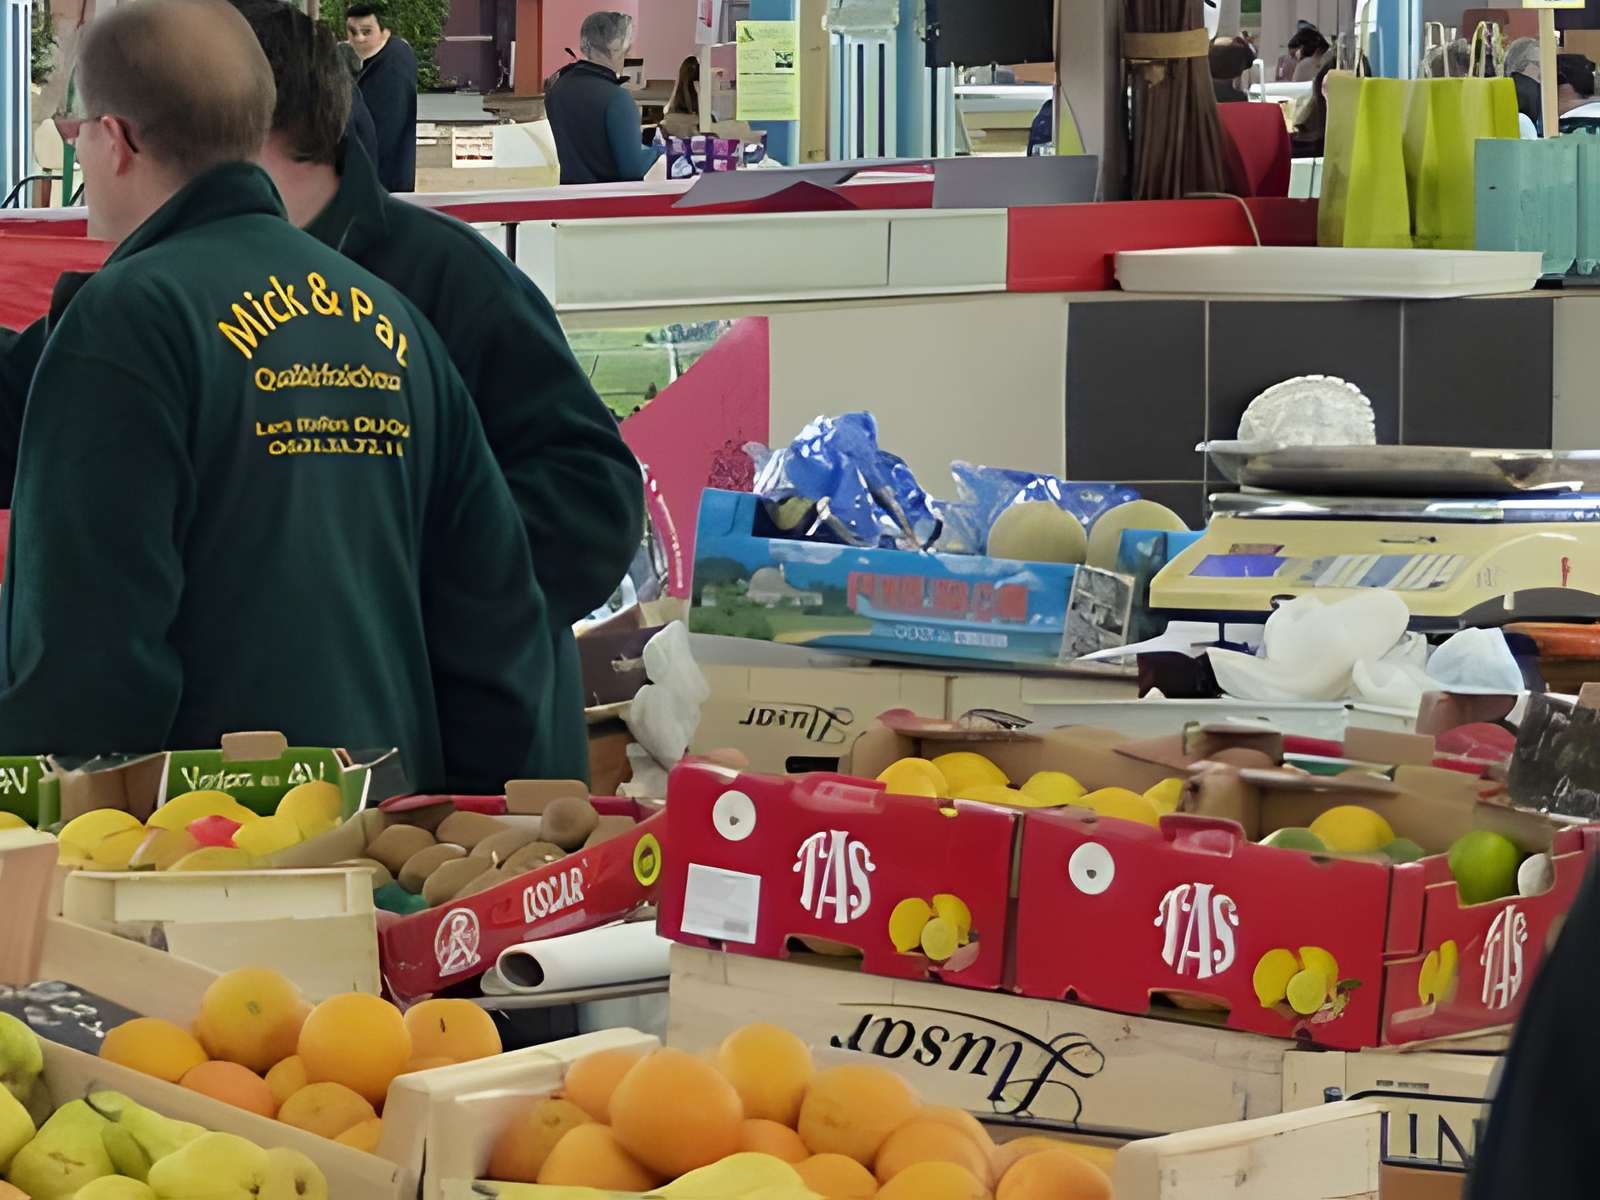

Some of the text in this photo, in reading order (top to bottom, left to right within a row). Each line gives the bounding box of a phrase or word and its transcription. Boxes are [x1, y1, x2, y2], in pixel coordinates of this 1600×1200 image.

[217, 275, 309, 360] Mick
[307, 271, 344, 316] &
[793, 829, 877, 924] TAS
[1154, 882, 1239, 979] TAS
